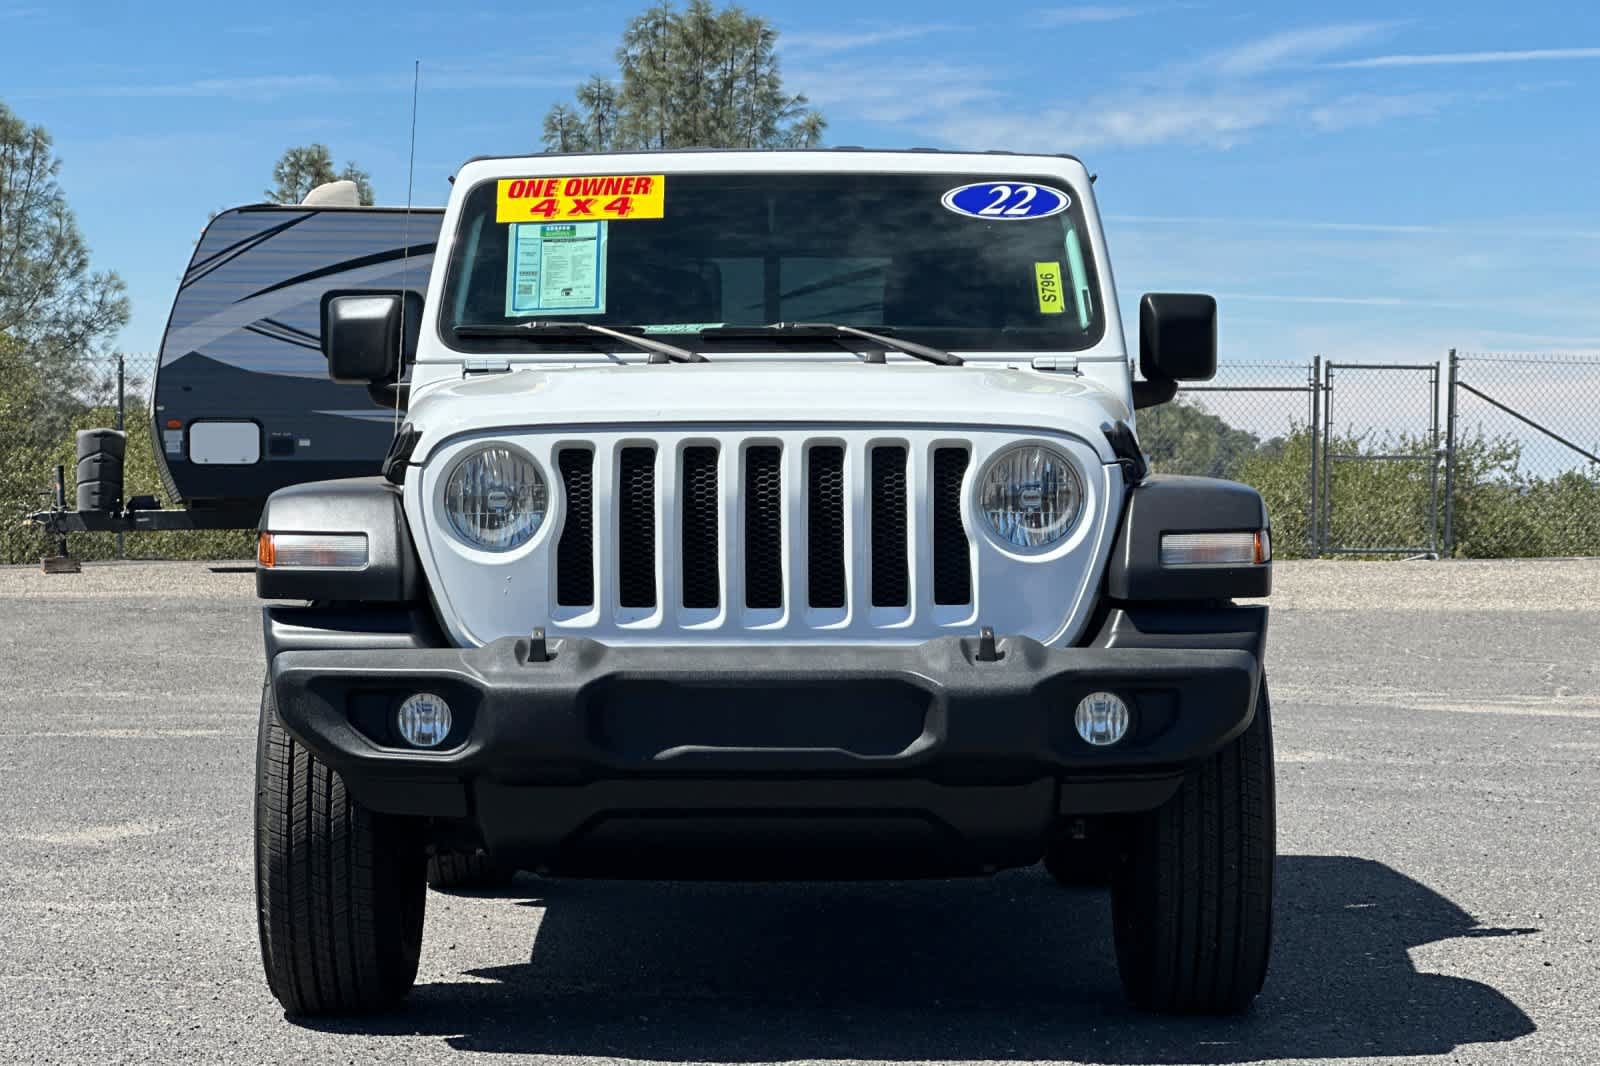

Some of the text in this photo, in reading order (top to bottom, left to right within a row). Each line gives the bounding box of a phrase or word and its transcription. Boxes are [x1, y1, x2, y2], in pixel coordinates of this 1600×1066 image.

[508, 177, 653, 198] ONE OWNER
[978, 185, 1037, 215] 22
[530, 199, 560, 218] 4
[604, 197, 634, 217] 4
[1040, 273, 1057, 303] S796
